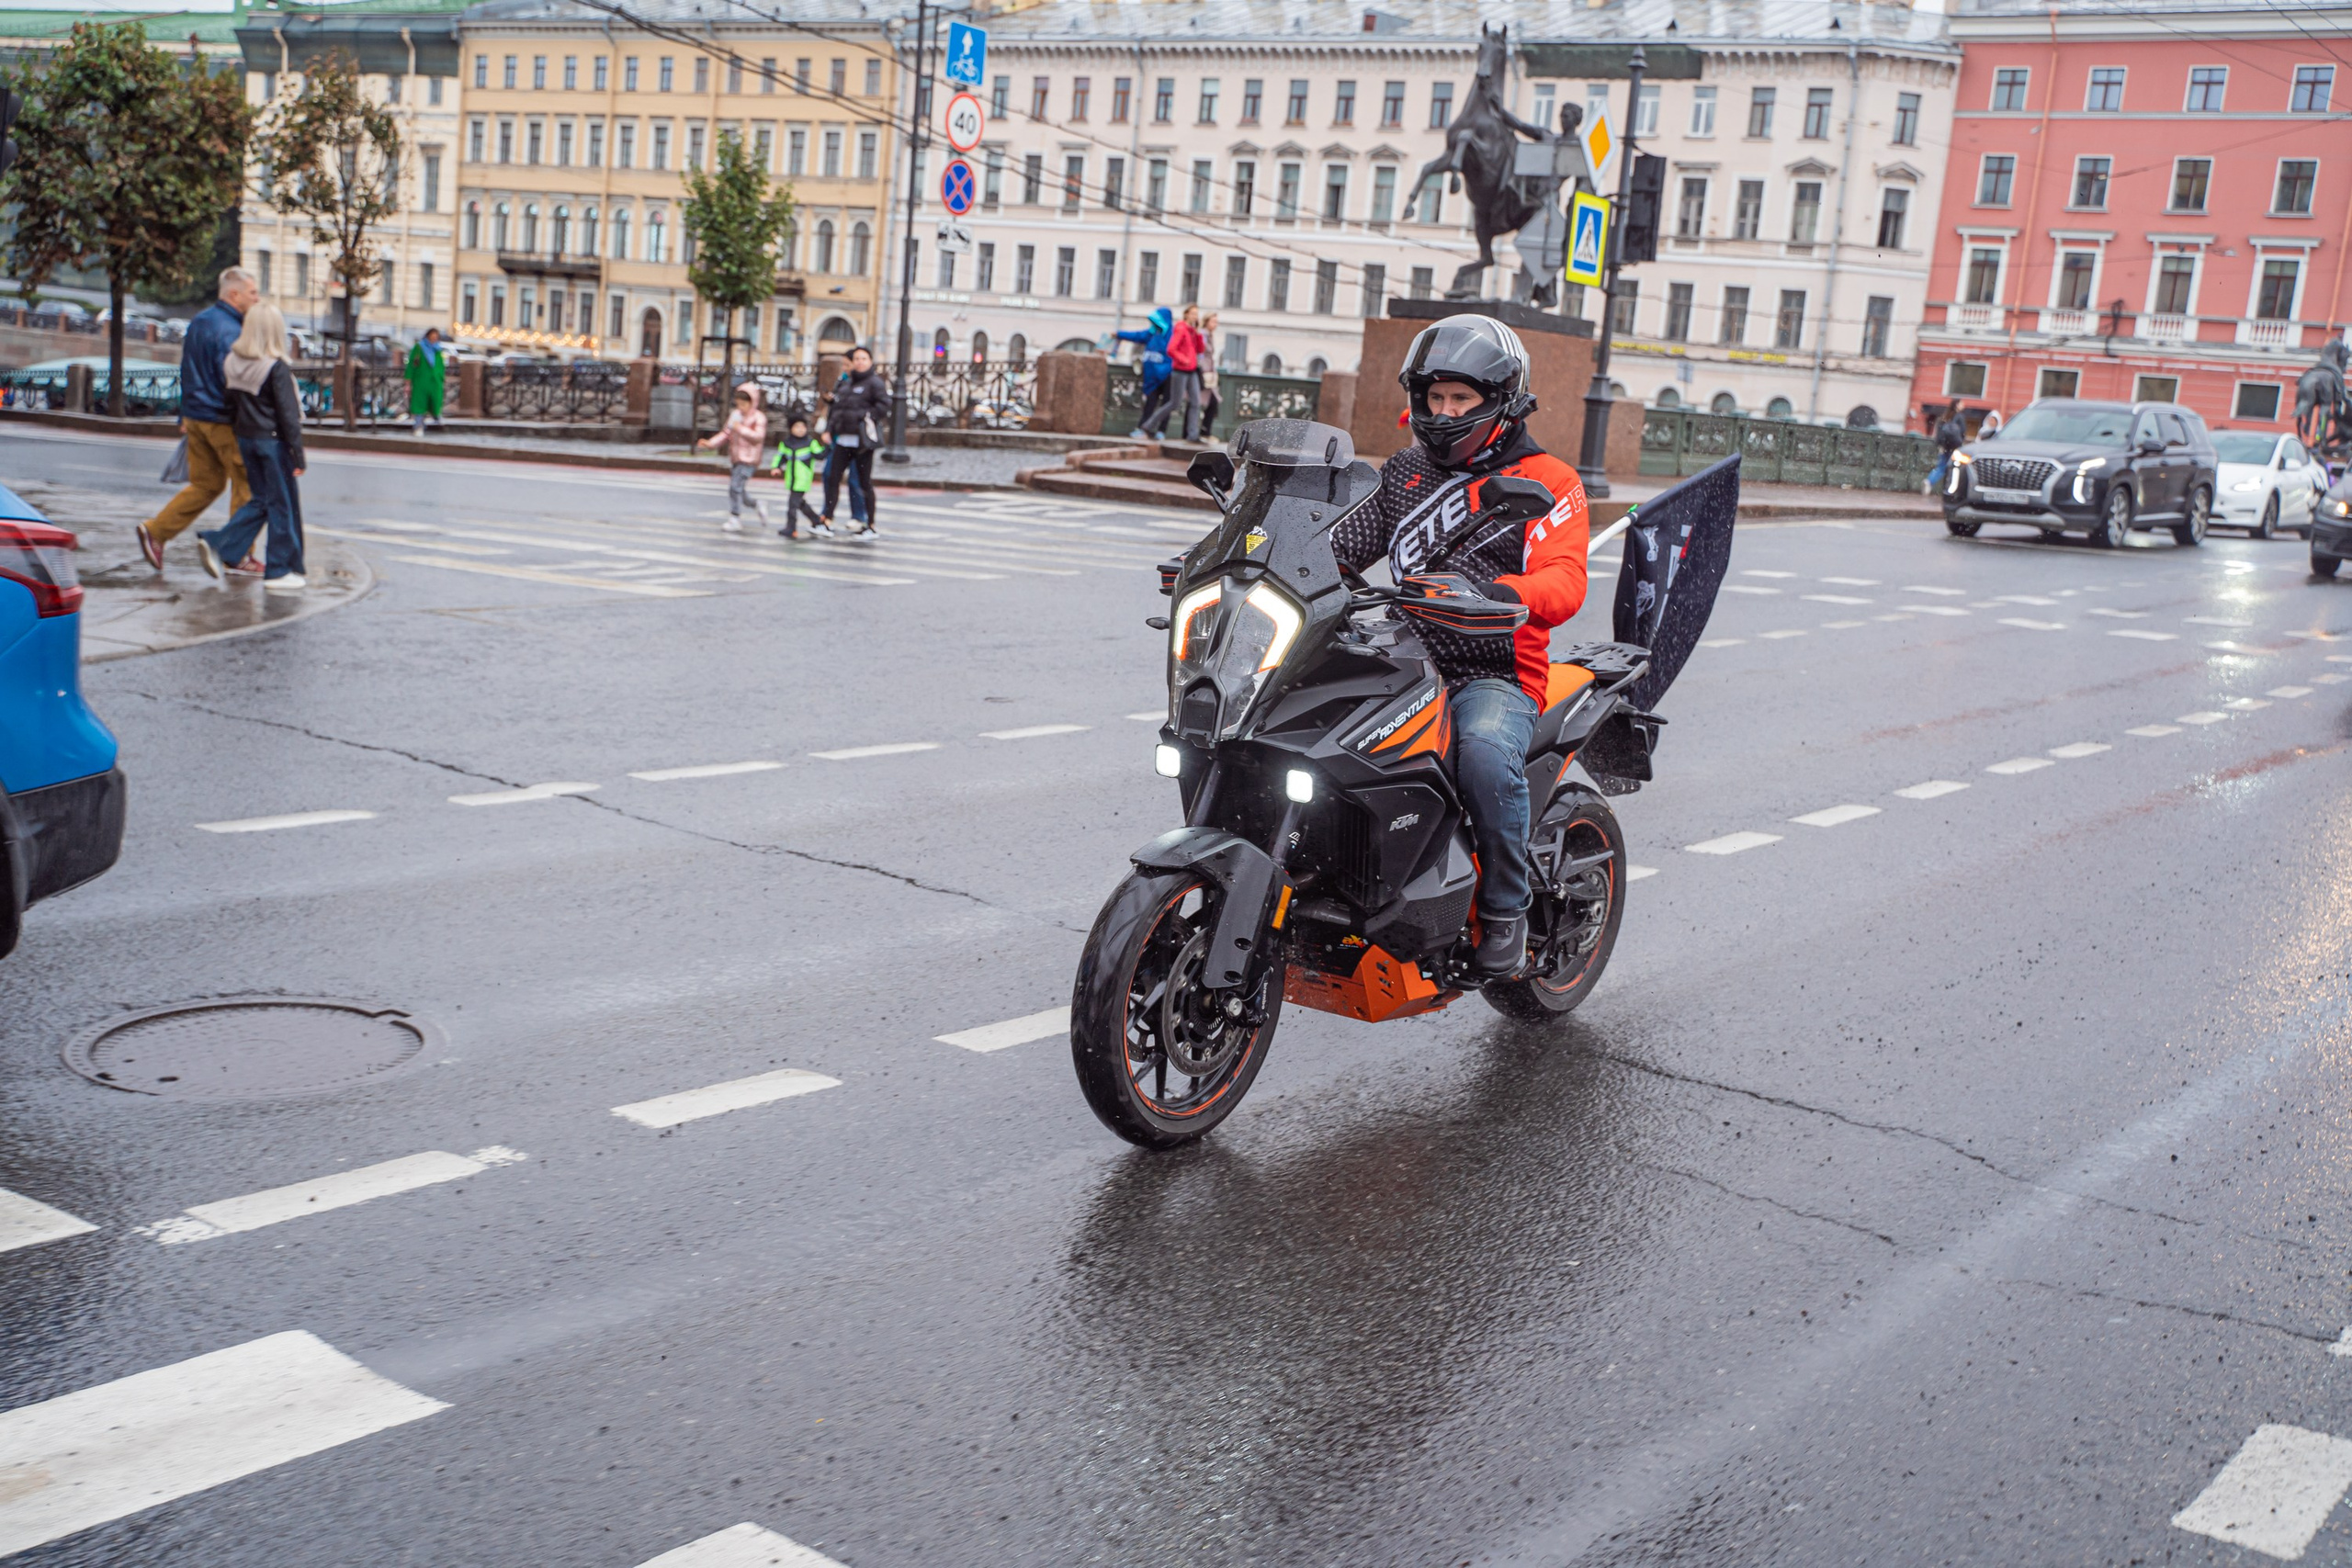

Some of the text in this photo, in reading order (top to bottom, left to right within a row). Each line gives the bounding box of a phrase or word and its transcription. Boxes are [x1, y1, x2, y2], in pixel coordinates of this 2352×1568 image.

[955, 111, 977, 135] 40
[1357, 686, 1435, 751] SUPER ADVENTURE
[1388, 813, 1419, 832] KTM
